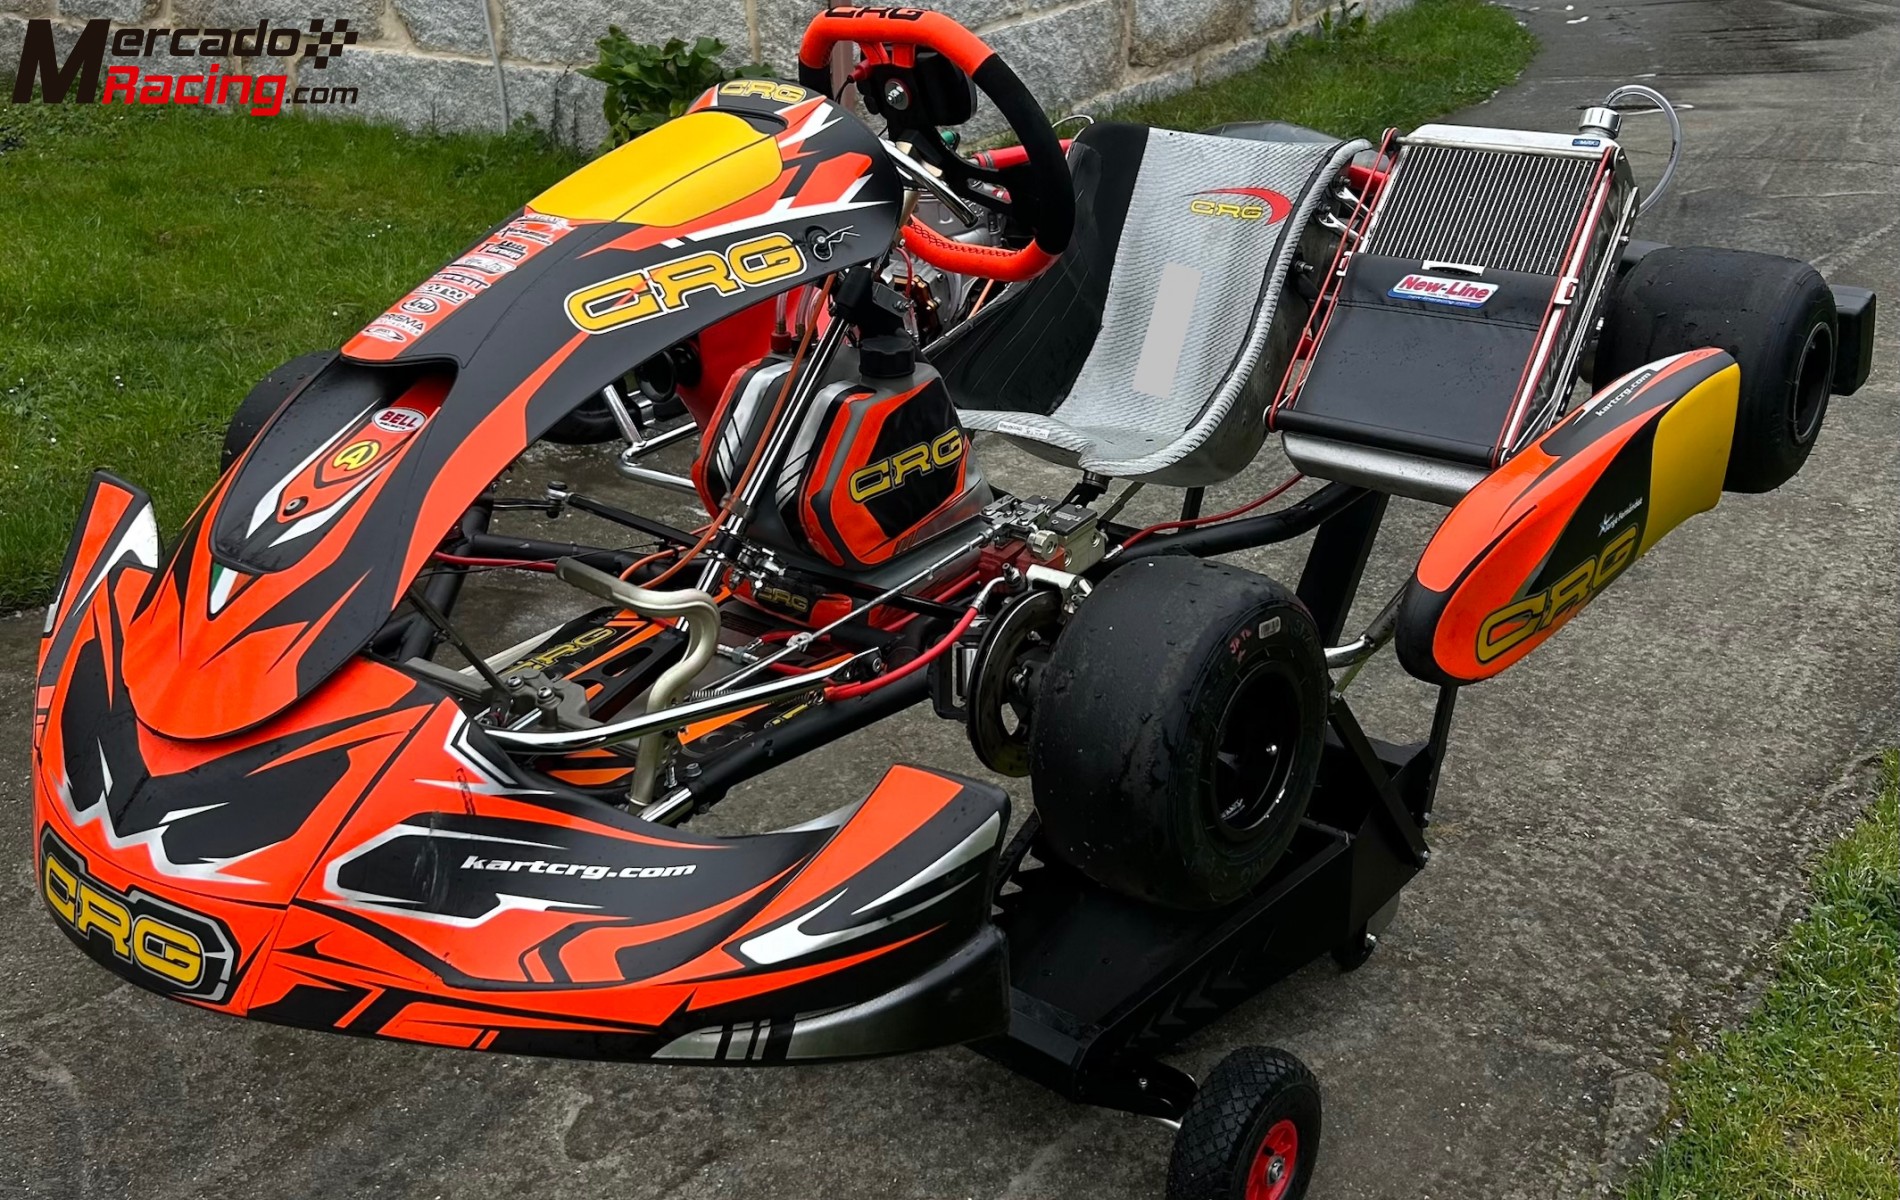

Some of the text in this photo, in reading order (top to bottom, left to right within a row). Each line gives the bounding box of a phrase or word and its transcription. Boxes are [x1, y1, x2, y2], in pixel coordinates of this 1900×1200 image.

[719, 79, 807, 104] CRG
[1190, 199, 1264, 220] CRG
[564, 232, 807, 335] CRG
[1399, 275, 1491, 299] New-Line
[1594, 371, 1652, 417] kartcrg.com
[380, 410, 418, 428] BELL
[849, 427, 963, 502] CRG
[1475, 522, 1640, 665] CRG
[460, 854, 697, 881] kartcrg.com
[45, 855, 205, 988] CRG
